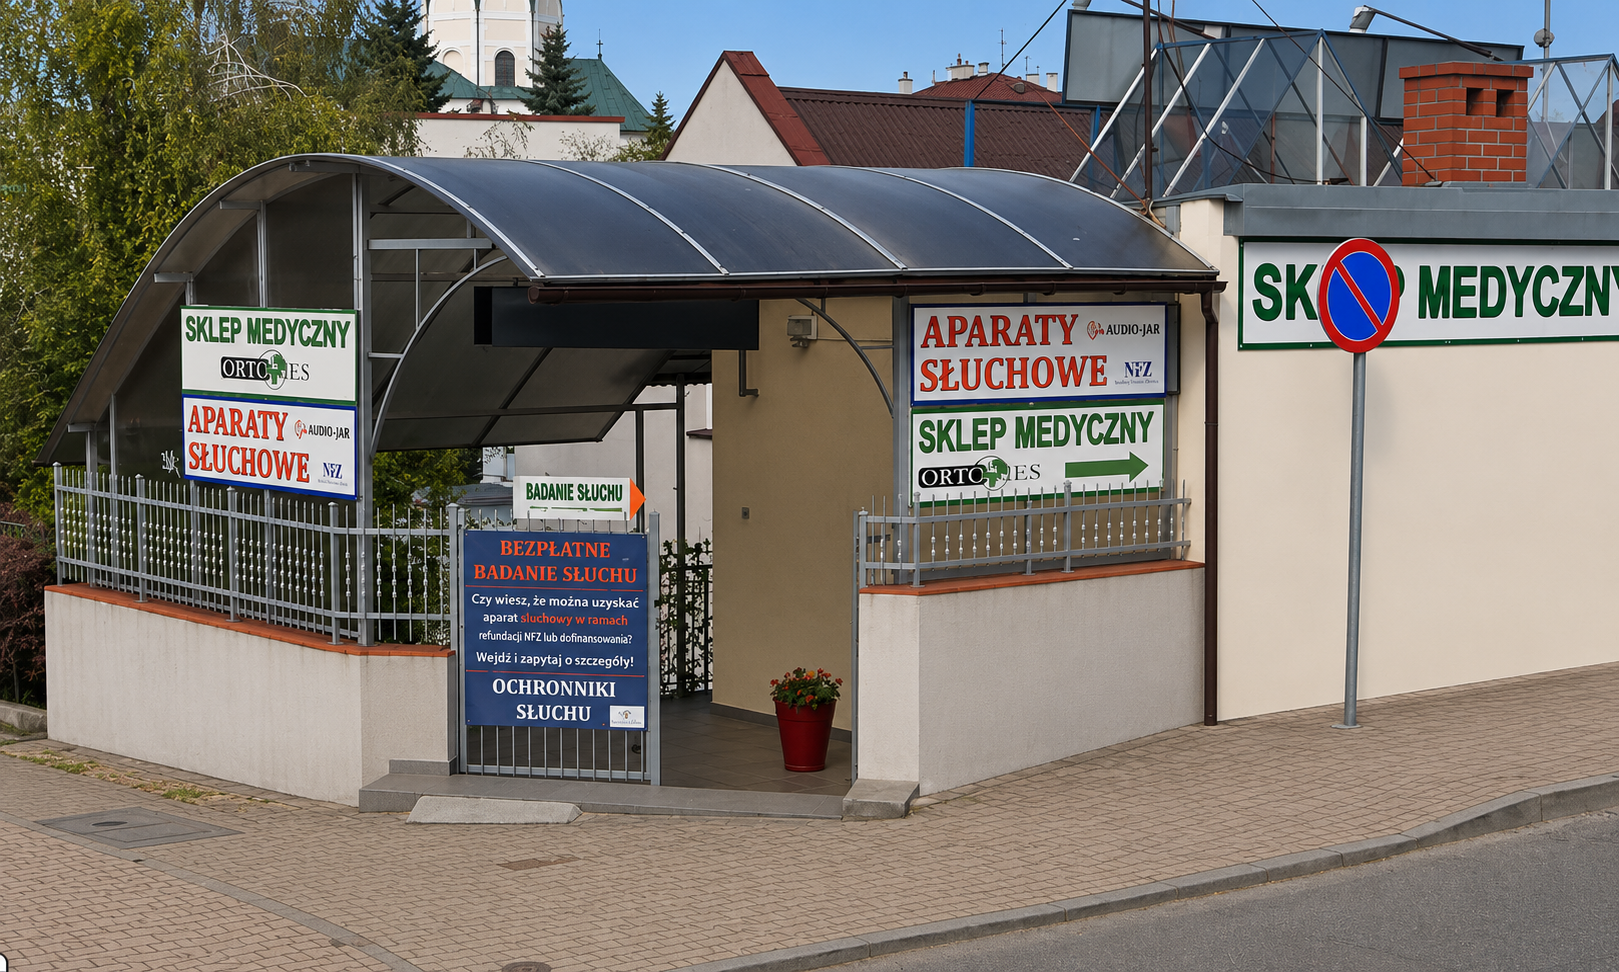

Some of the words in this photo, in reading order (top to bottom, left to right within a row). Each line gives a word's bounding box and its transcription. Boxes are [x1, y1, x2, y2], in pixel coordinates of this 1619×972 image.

[185, 315, 242, 343] SKLEP
[247, 317, 351, 348] MEDYCZNY
[920, 313, 1079, 348] APARATY
[1106, 323, 1161, 337] AUDIO-JAR
[920, 354, 1107, 392] SŁUCHOWE
[1124, 361, 1152, 378] NFZ
[187, 404, 289, 441] APARATY
[918, 416, 1007, 454] SKLEP
[1015, 411, 1155, 449] MEDYCZNY
[188, 441, 310, 483] SŁUCHOWE
[525, 482, 574, 501] BADANIE
[577, 483, 623, 502] SŁUCHU
[500, 539, 611, 558] BEZPŁATNE
[474, 564, 558, 582] BADANIE
[562, 566, 638, 584] SŁUCHU
[471, 593, 492, 607] Czy
[494, 594, 531, 608] wiesz,
[532, 595, 546, 607] że
[549, 595, 589, 608] można
[591, 596, 640, 610] uzyskać
[483, 613, 519, 625] aparat
[575, 615, 586, 625] w
[587, 614, 628, 626] ramach
[478, 631, 523, 643] refundacji
[524, 632, 542, 642] NFZ
[543, 632, 558, 643] lub
[559, 632, 633, 645] dofinansowania?
[476, 651, 512, 665] Wejdź
[514, 652, 518, 663] i
[520, 653, 562, 668] zapytaj
[564, 657, 573, 666] o
[492, 678, 616, 698] OCHRONNIKI
[516, 703, 592, 722] SŁUCHU
